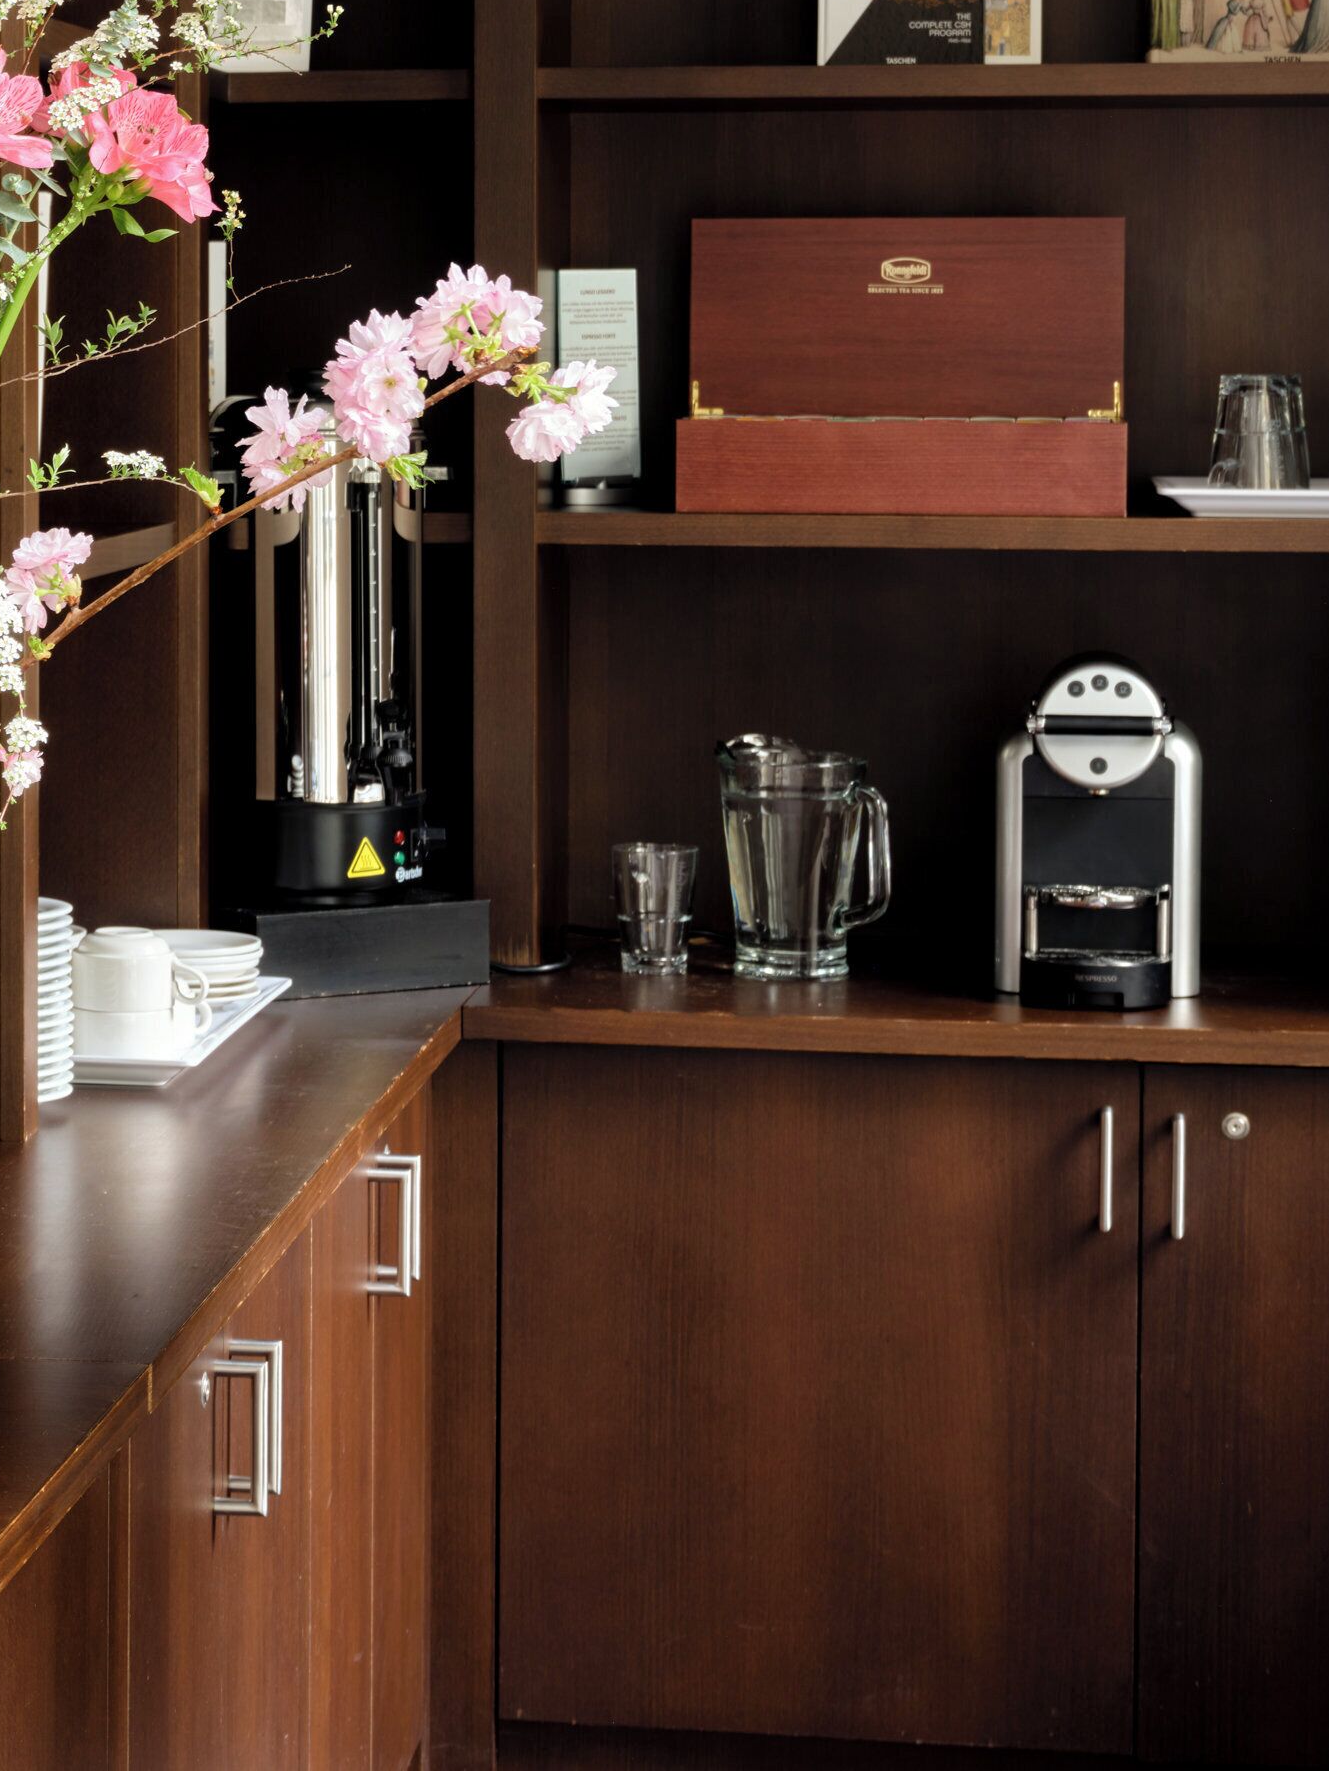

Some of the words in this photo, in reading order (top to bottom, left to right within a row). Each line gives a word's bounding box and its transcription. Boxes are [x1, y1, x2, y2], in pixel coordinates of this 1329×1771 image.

[956, 12, 971, 20] THE
[908, 21, 952, 29] COMPLETE
[954, 21, 971, 29] CSH
[928, 29, 971, 37] PROGRAM
